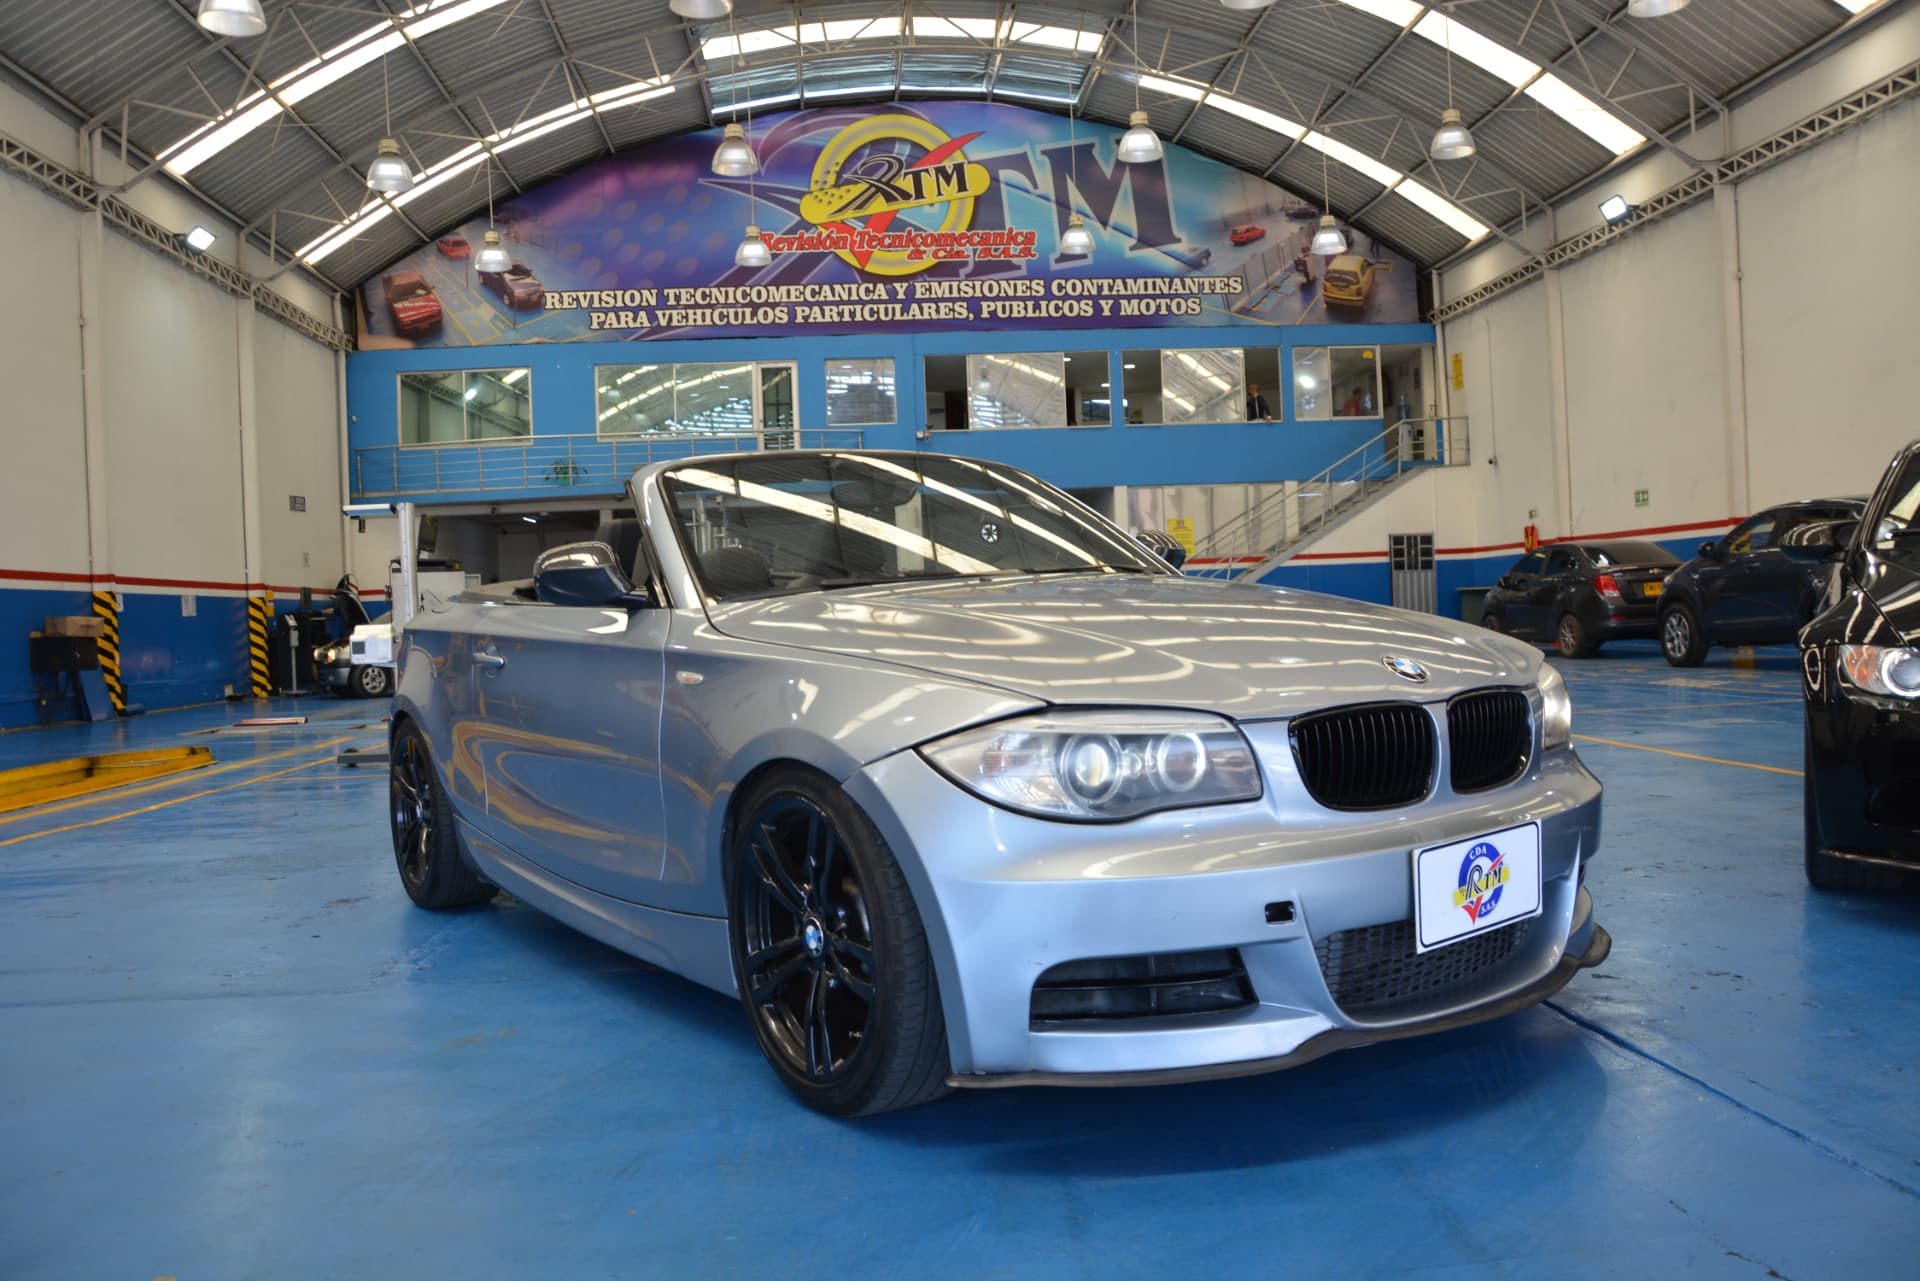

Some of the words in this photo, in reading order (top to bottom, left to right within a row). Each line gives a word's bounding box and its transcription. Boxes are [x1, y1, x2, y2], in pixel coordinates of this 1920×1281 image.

[827, 153, 970, 217] RTM
[760, 228, 849, 251] Revisión
[854, 227, 1037, 250] Tecnicomecanica
[906, 248, 928, 261] &
[543, 288, 658, 310] REVISION
[663, 282, 889, 306] TECNICOMECANICA
[892, 282, 909, 300] Y
[913, 279, 1046, 300] EMISIONES
[1050, 276, 1244, 297] CONTAMINANTES
[589, 311, 652, 330] PARA
[654, 306, 789, 328] VEHICULOS
[794, 301, 975, 323] PARTICULARES,
[979, 299, 1095, 318] PUBLICOS
[1099, 299, 1115, 317] Y
[1119, 297, 1203, 316] MOTOS
[1469, 844, 1488, 860] CDA
[1465, 865, 1502, 901] RTM
